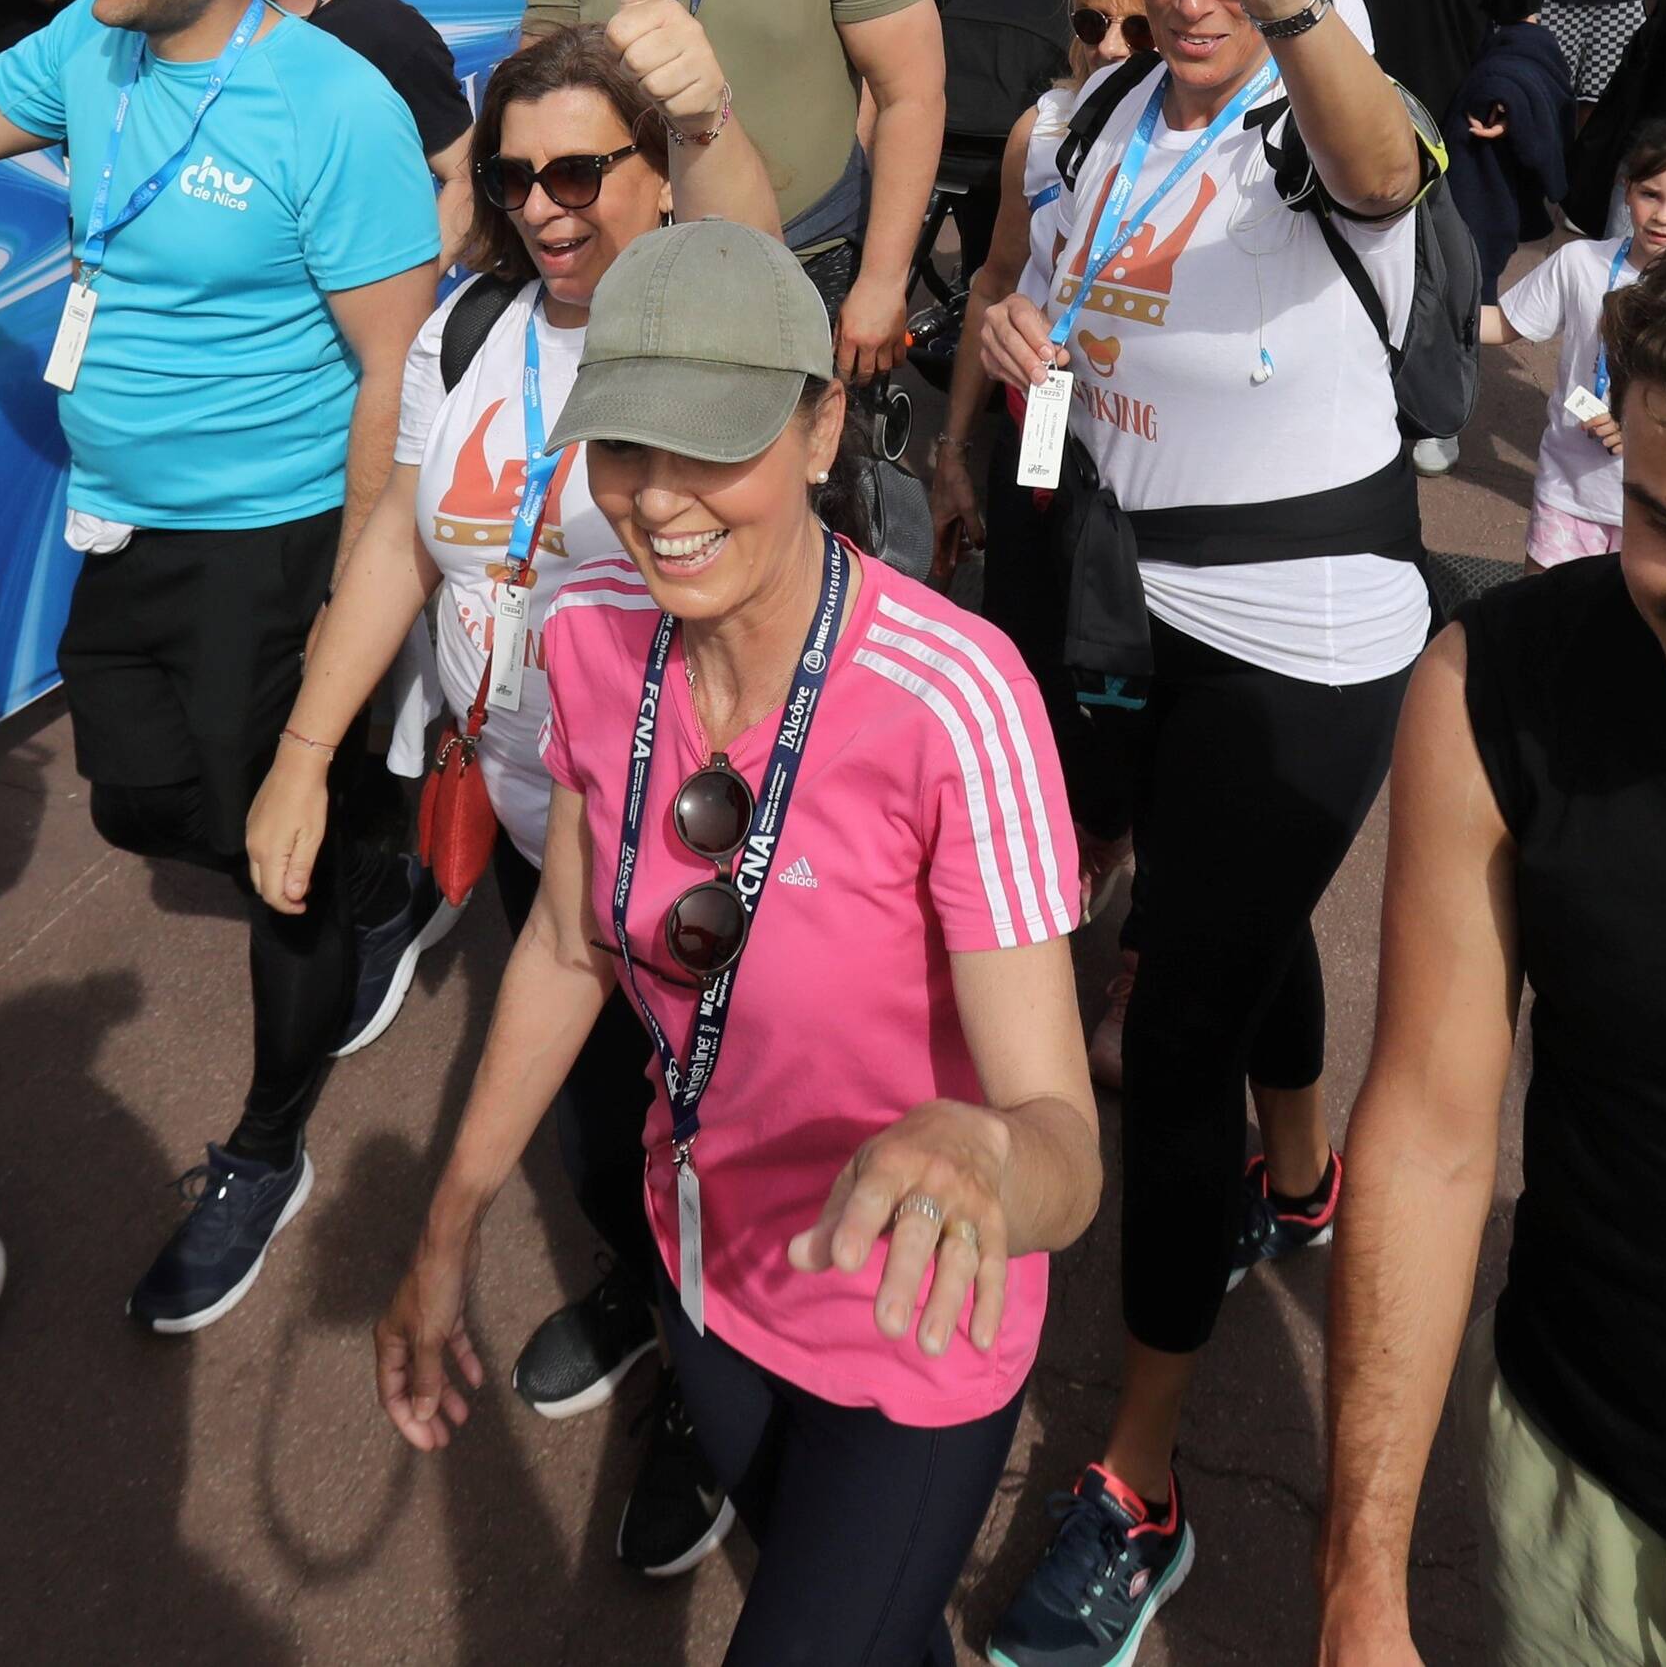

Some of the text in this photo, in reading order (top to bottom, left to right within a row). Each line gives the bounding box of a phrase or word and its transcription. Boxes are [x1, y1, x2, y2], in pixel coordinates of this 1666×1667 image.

[180, 155, 254, 195] chu
[192, 187, 248, 212] de Nice
[633, 680, 661, 758] FCNA
[777, 869, 819, 889] adidas
[693, 1035, 712, 1065] line
[686, 1055, 711, 1094] finish
